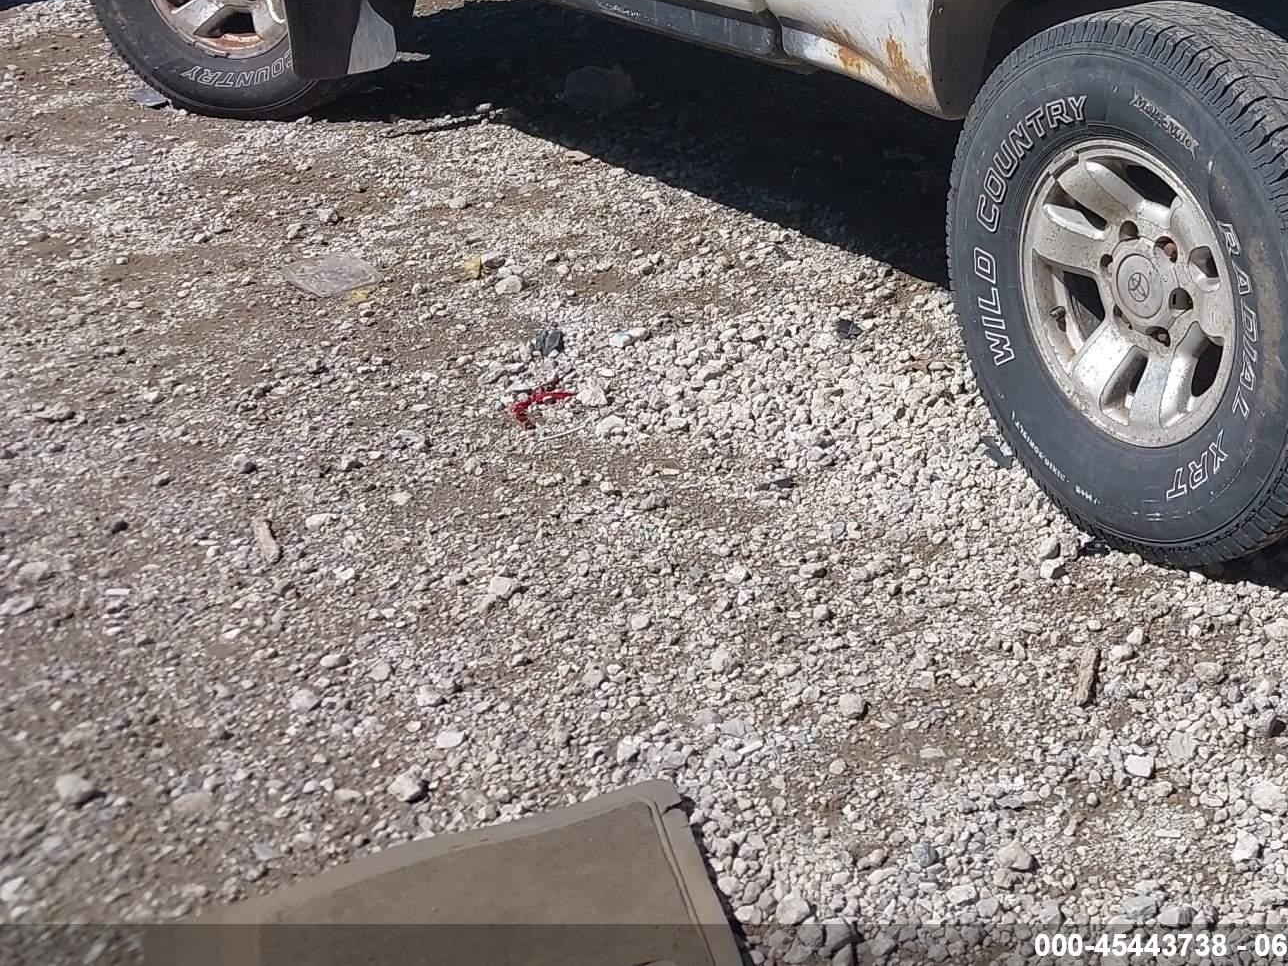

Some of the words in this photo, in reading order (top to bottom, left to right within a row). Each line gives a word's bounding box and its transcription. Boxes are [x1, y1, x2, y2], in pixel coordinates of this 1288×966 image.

[976, 94, 1089, 233] COUNTRY
[973, 246, 1016, 367] WILD
[1217, 220, 1259, 420] RADIAL
[1165, 428, 1229, 502] XRT
